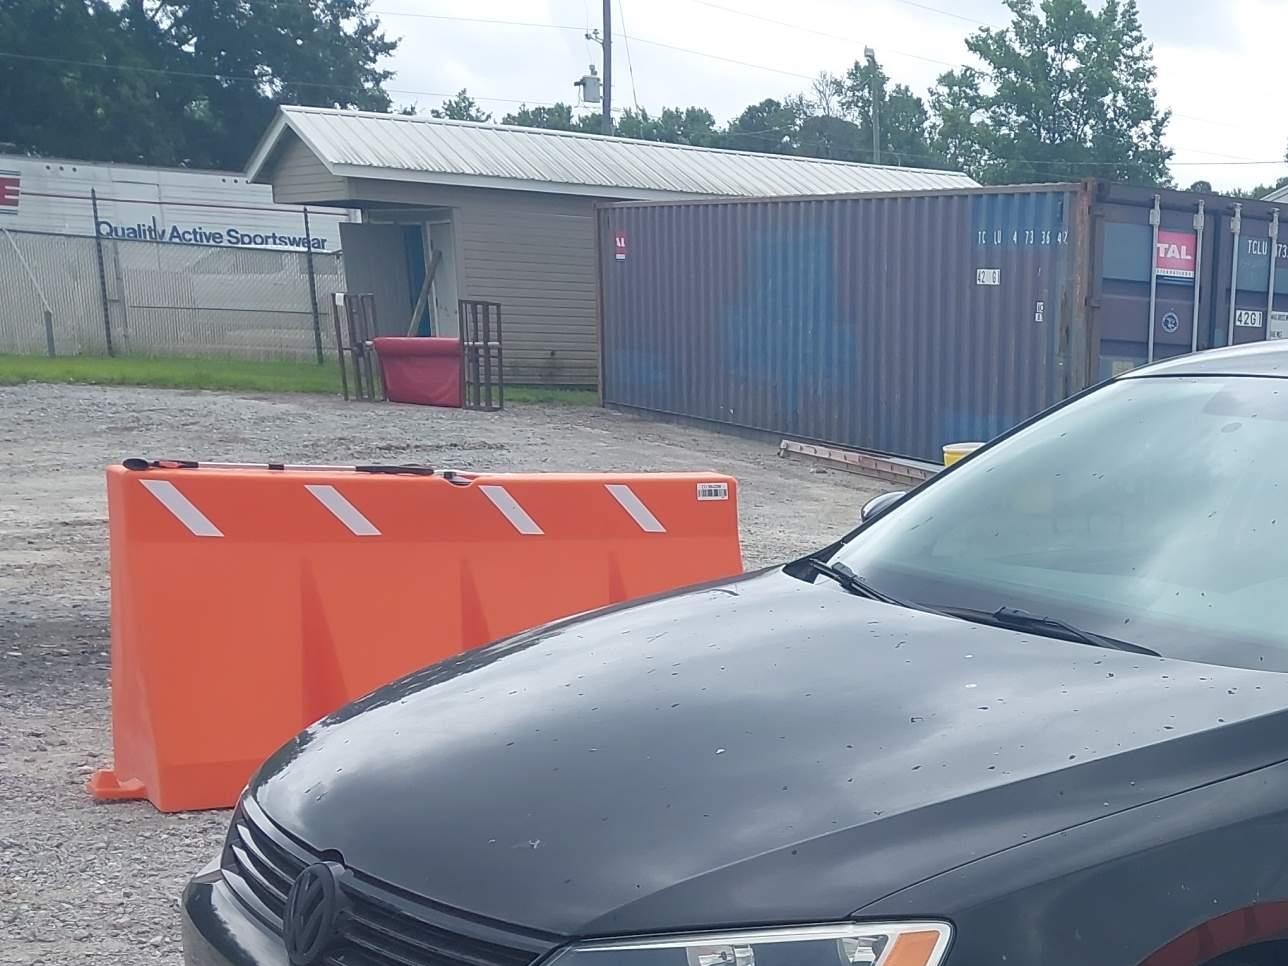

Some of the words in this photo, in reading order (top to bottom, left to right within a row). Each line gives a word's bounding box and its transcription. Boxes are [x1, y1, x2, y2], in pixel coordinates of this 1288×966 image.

[96, 221, 166, 240] Quality
[169, 225, 223, 245] Active
[226, 231, 327, 250] Sportswear
[1157, 243, 1192, 259] TAL
[1248, 240, 1268, 255] TCLU
